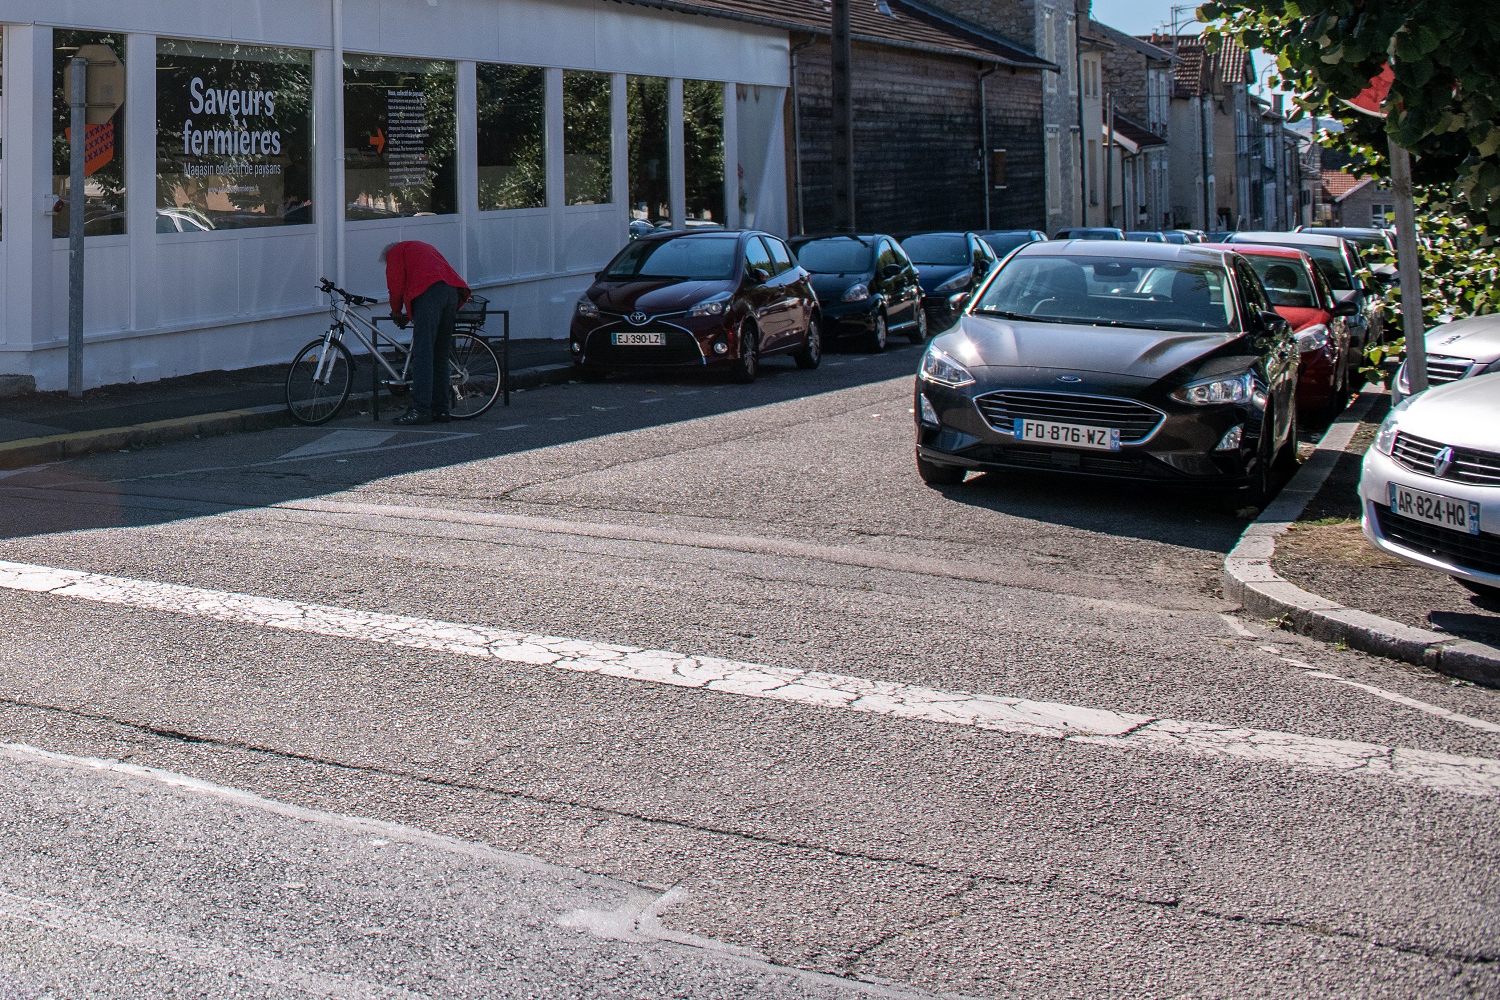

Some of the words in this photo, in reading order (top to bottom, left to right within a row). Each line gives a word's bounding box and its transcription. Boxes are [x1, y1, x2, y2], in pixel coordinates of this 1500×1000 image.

[190, 77, 274, 116] Saveurs
[183, 119, 280, 154] fermières
[184, 162, 214, 179] Magasin
[215, 161, 244, 175] collectif
[254, 164, 281, 178] paysans
[617, 334, 660, 344] EJ-390-LZ
[1025, 422, 1106, 446] FD-876-WZ
[1398, 490, 1466, 527] AR-824-HQ
